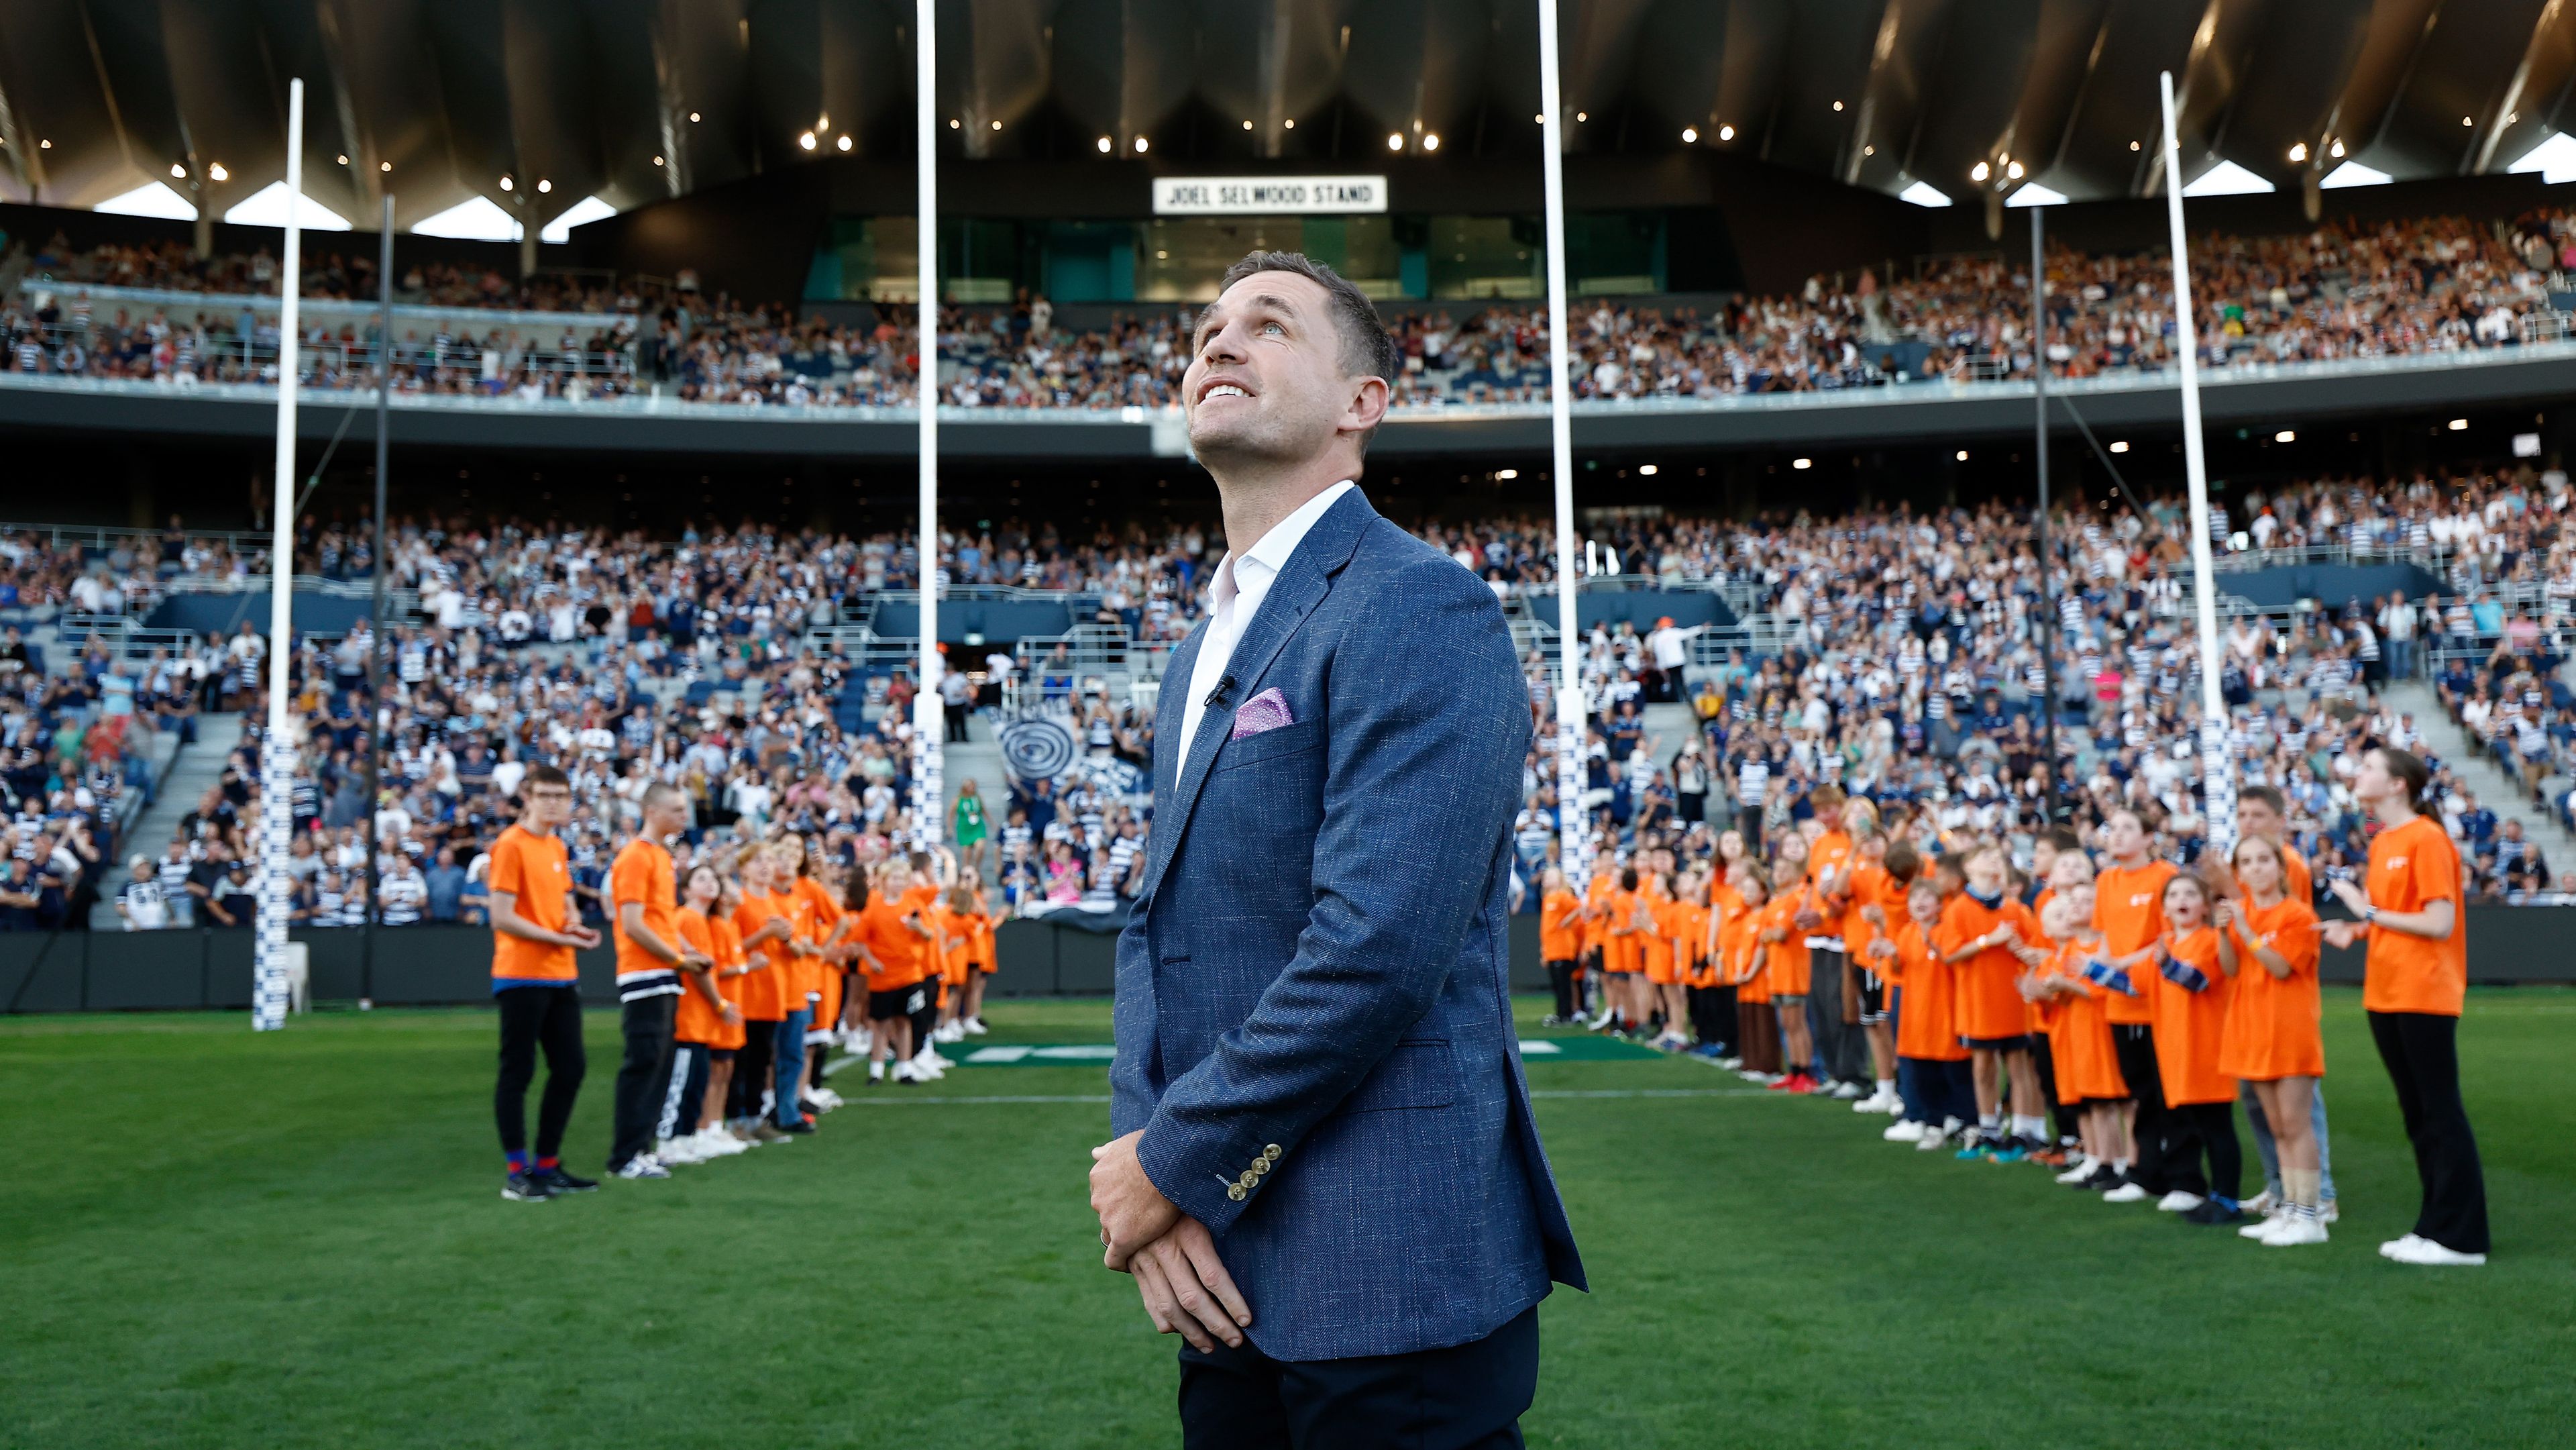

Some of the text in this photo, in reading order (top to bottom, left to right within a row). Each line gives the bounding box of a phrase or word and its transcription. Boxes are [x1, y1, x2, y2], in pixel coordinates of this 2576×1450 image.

[1168, 184, 1373, 205] JOEL SELWOOD STAND
